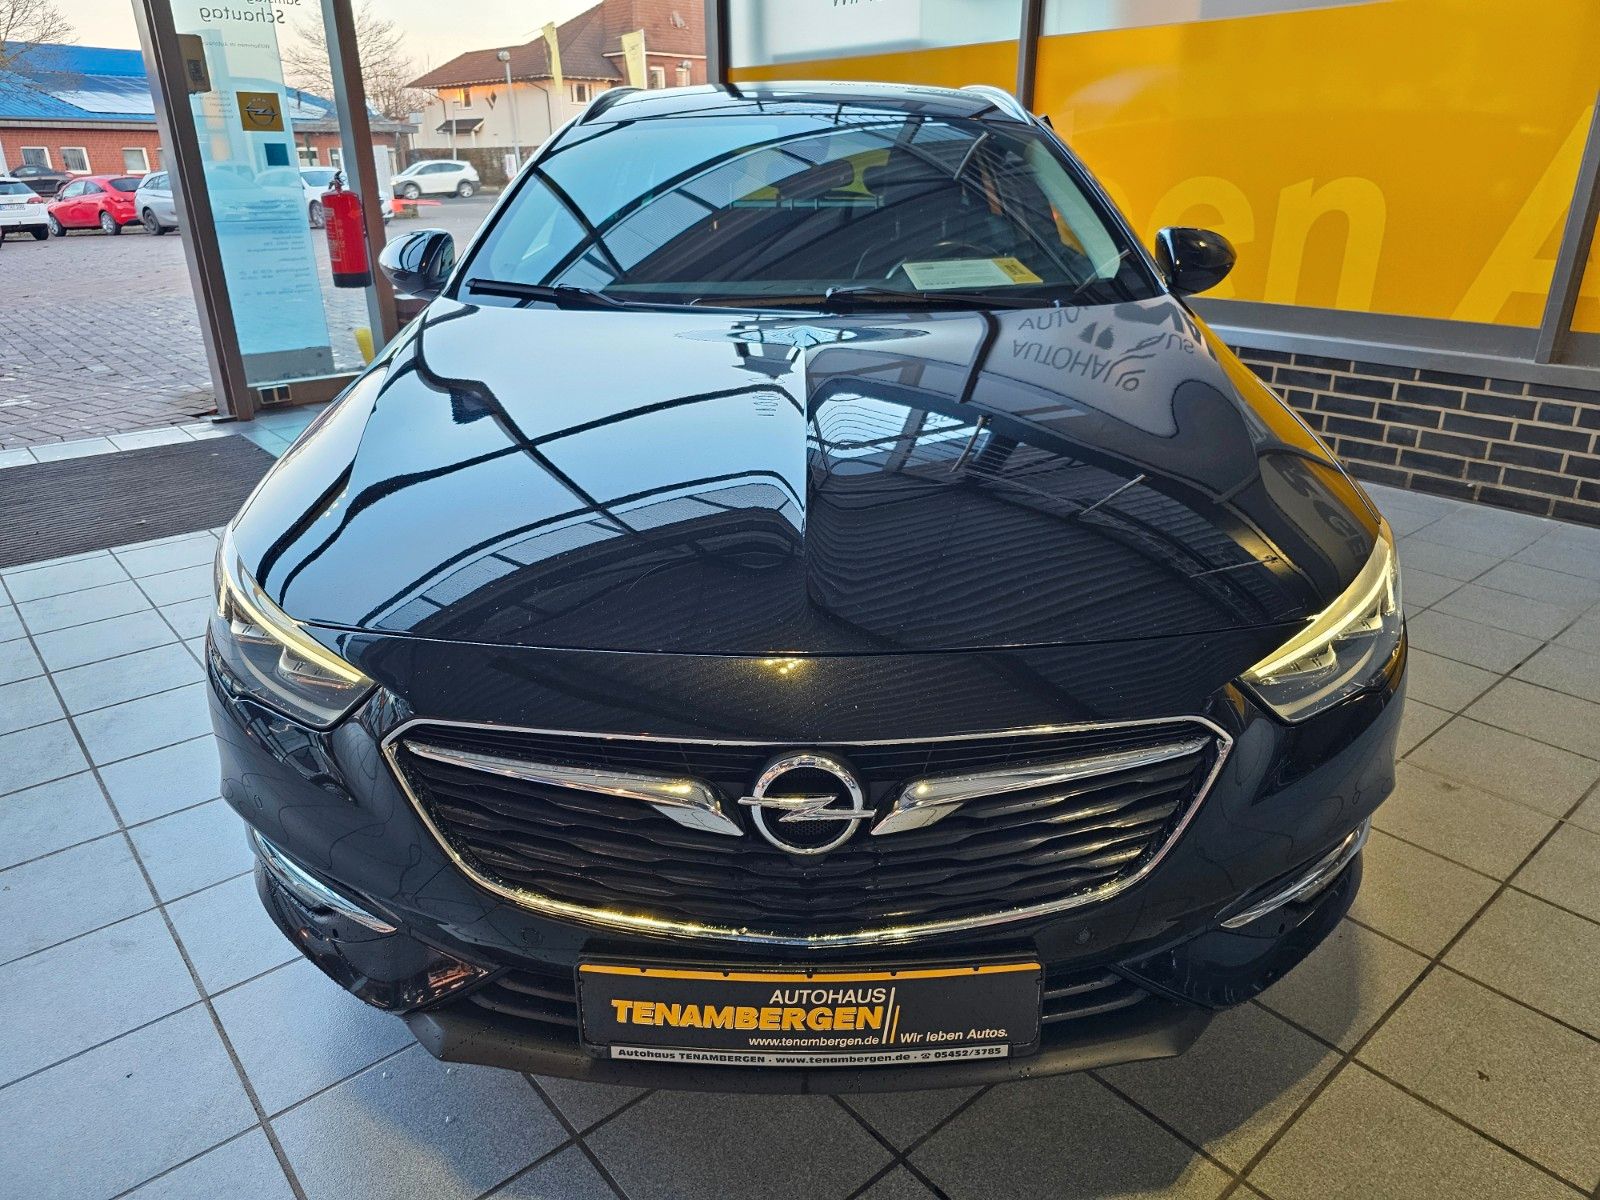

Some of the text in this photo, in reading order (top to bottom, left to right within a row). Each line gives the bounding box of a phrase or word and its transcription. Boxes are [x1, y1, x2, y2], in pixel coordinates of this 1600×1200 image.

[769, 987, 886, 1004] AUTOHAUS
[611, 999, 884, 1031] TENAMBERGEN
[748, 1036, 880, 1048] www.tenambergen.de
[900, 1027, 1009, 1044] Wir leben Autos.
[618, 1046, 1002, 1065] Autohaus TENAMBERGEN www.tenambergen.de 05452/3785
